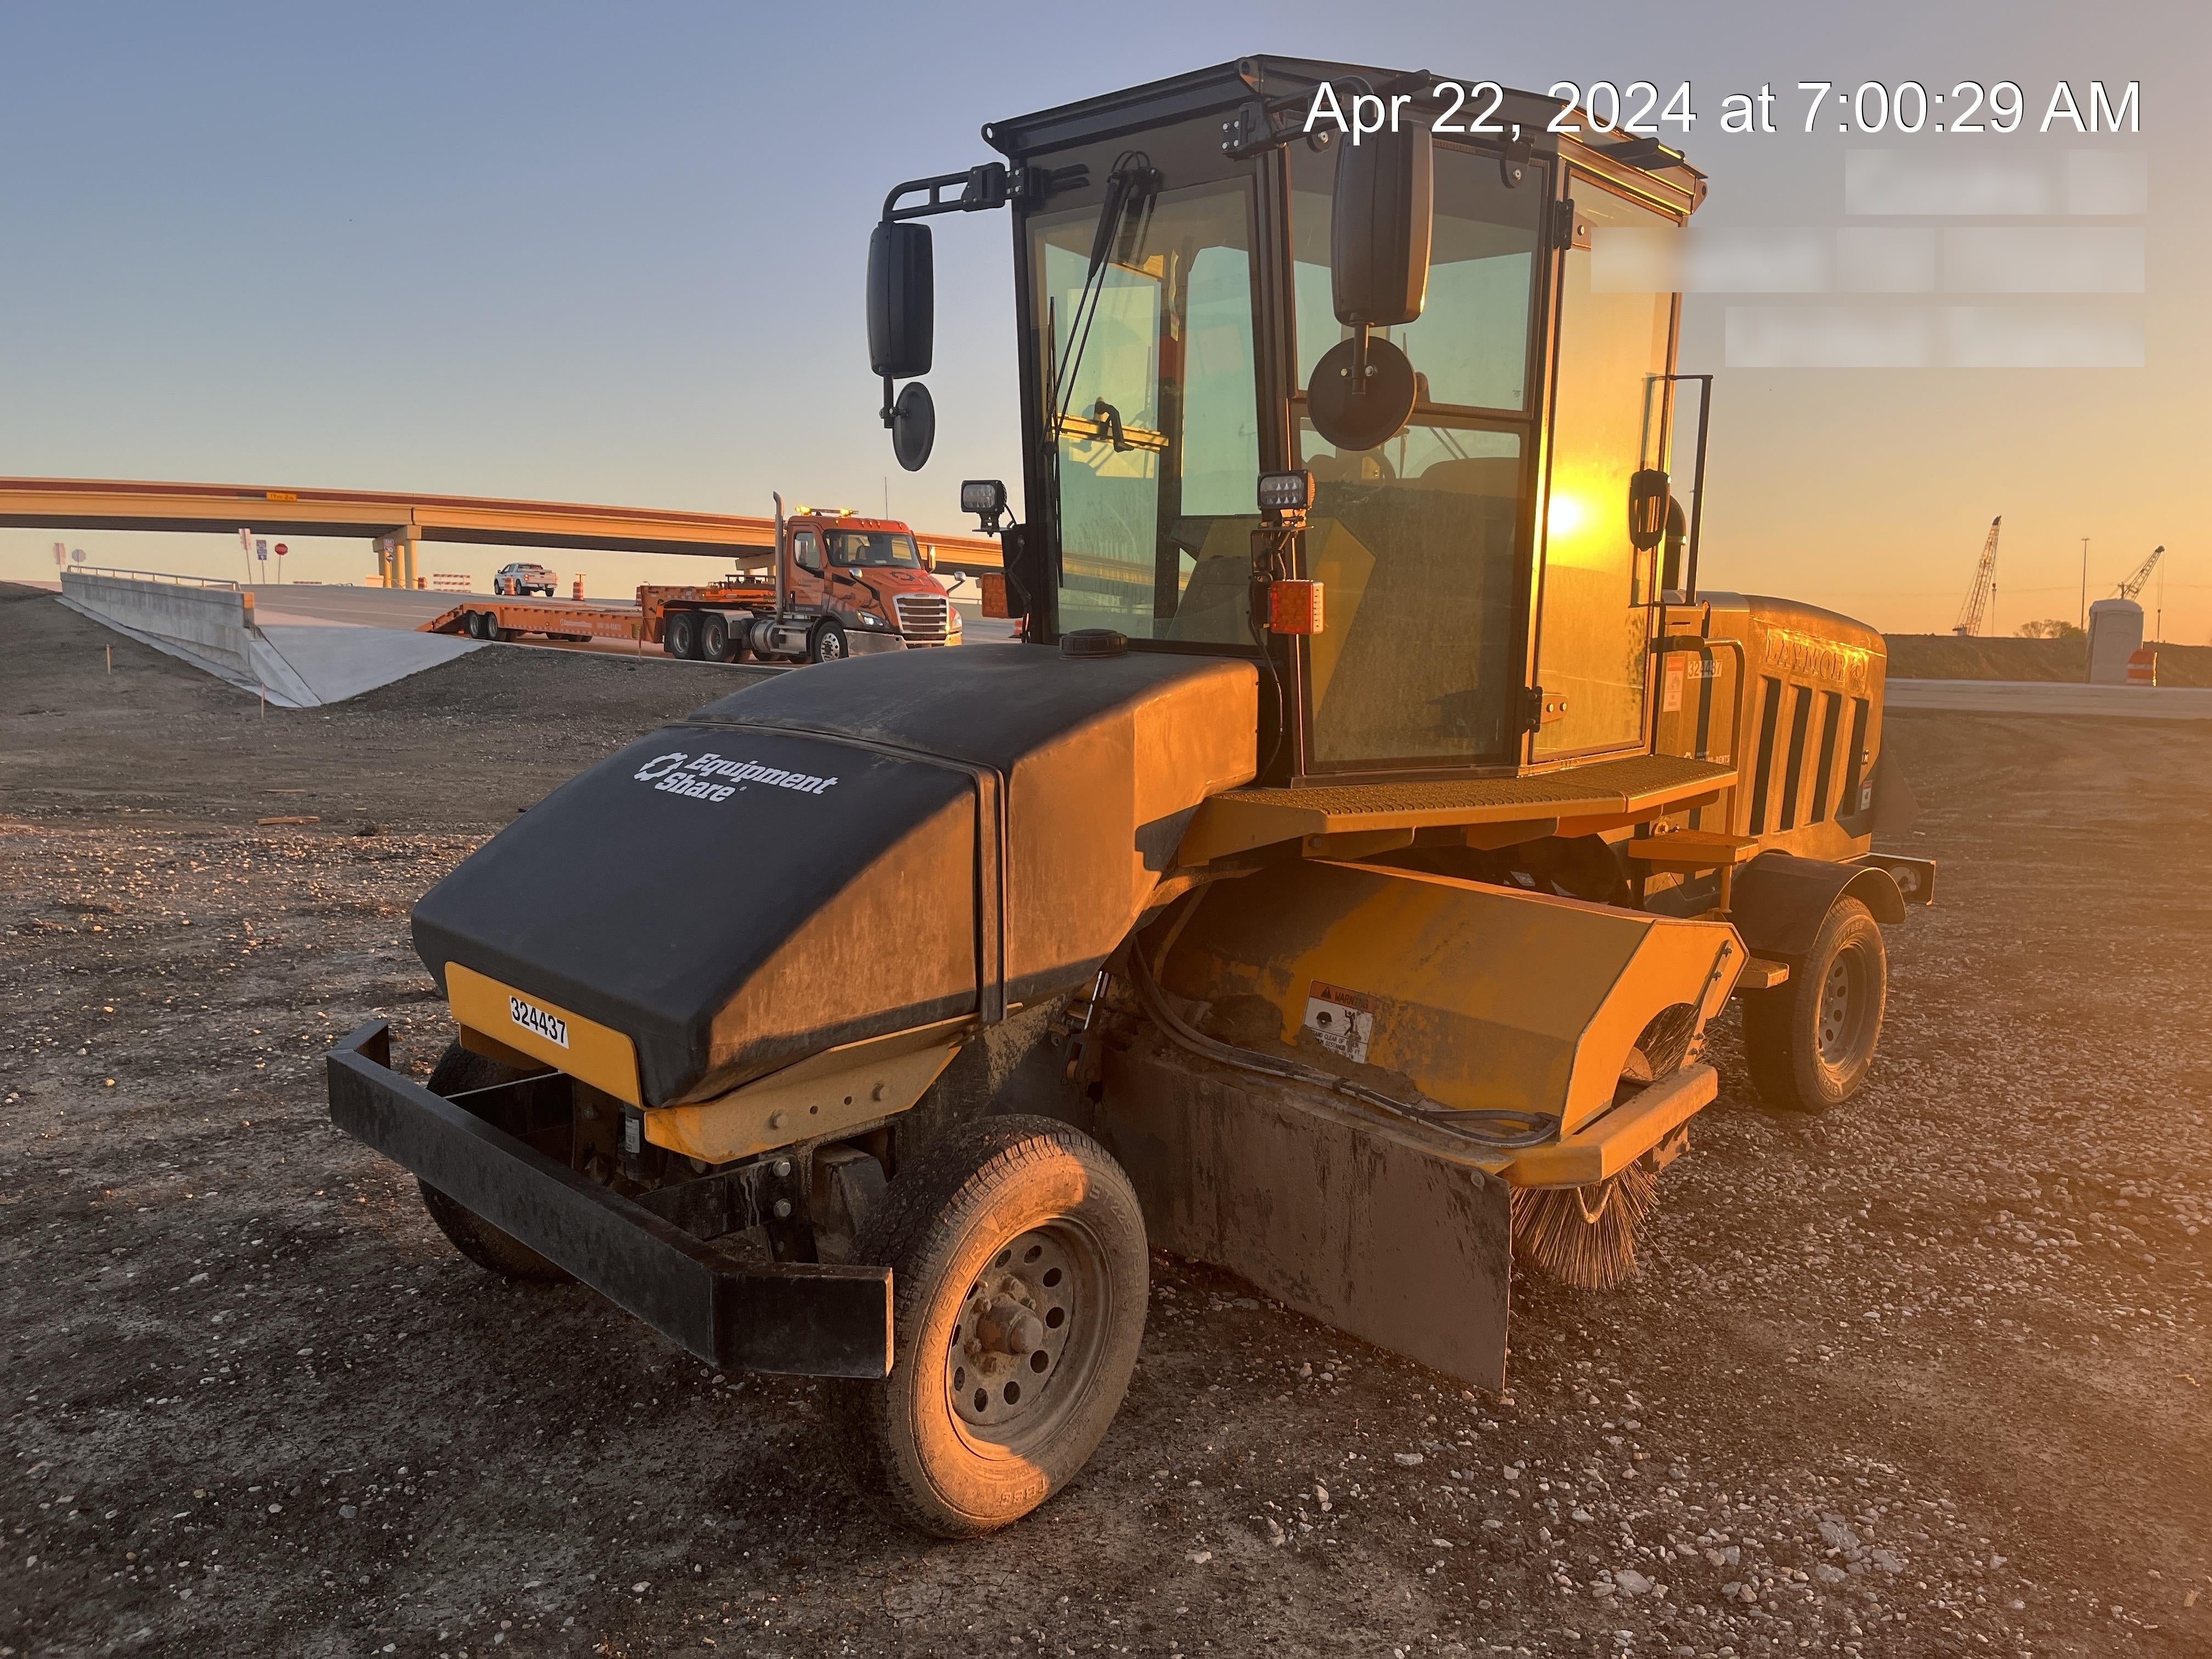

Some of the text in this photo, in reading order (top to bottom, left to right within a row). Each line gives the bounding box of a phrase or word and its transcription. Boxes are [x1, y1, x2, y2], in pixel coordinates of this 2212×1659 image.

[1766, 634, 1845, 683] LAYMOR
[654, 772, 736, 803] Share
[684, 753, 839, 795] Equipment
[1335, 991, 1369, 1009] WARNING
[511, 997, 566, 1043] 324437
[1324, 1034, 1338, 1042] CLEAR
